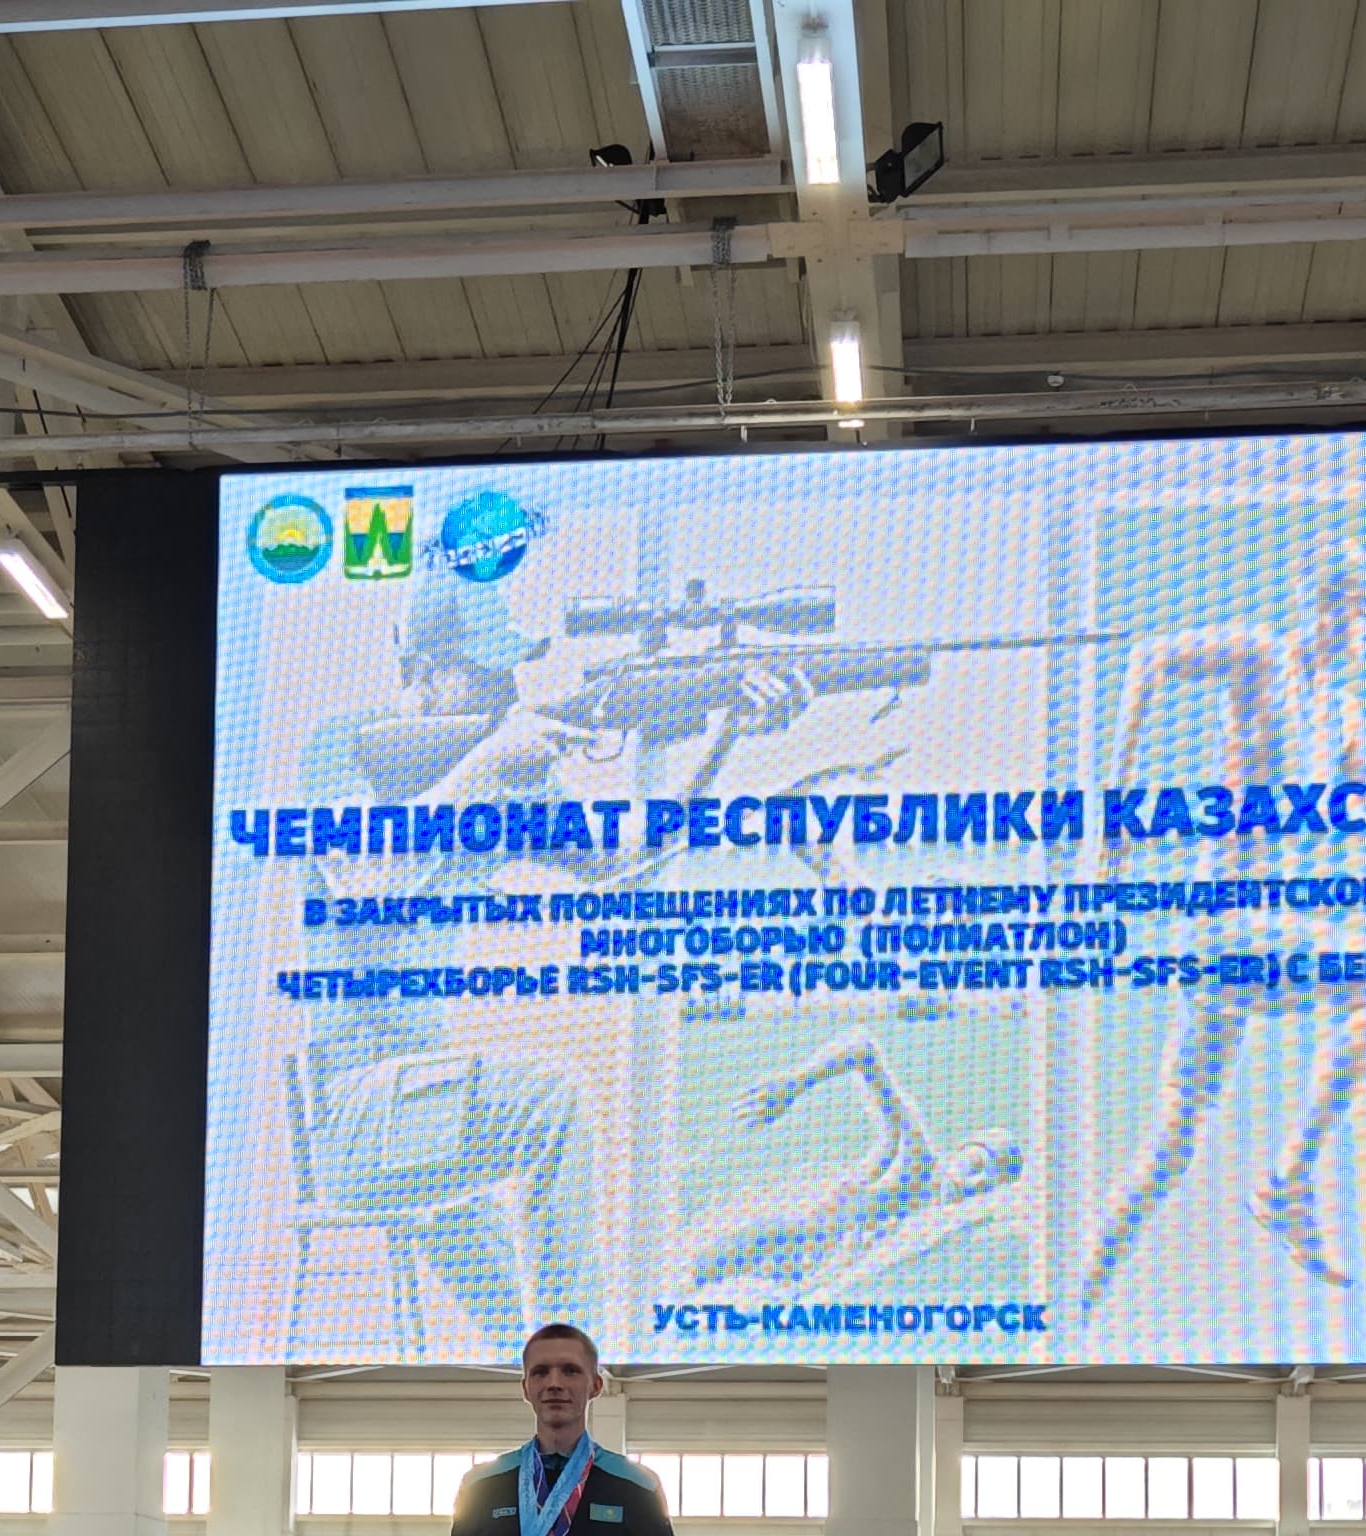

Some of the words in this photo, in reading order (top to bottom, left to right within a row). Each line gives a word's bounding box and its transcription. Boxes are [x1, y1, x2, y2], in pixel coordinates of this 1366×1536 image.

[232, 800, 631, 857] ЧЕМПИОНАТ
[645, 788, 1084, 848] РЕСПУБЛИКИ
[304, 897, 327, 926] В
[335, 893, 543, 926] ЗАКРЫТЫХ
[549, 888, 817, 924] ПОМЕЩЕНИЯХ
[823, 886, 876, 917] ПО
[882, 884, 1058, 917] ЛЕТНЕМУ
[580, 924, 845, 958] МНОГОБОРЬЮ
[861, 918, 1127, 959] (ПОЛИАТЛОН)
[277, 965, 560, 1001] ЧЕТЫРЕХБОРЬЕ
[567, 960, 784, 996] RSH-SFS-ER
[789, 957, 1034, 998] (FOUR-EVENT
[1038, 951, 1281, 990] RSH-SFS-ER)
[653, 1303, 1048, 1332] УСТЬ-КАМЕНОГОРСК
